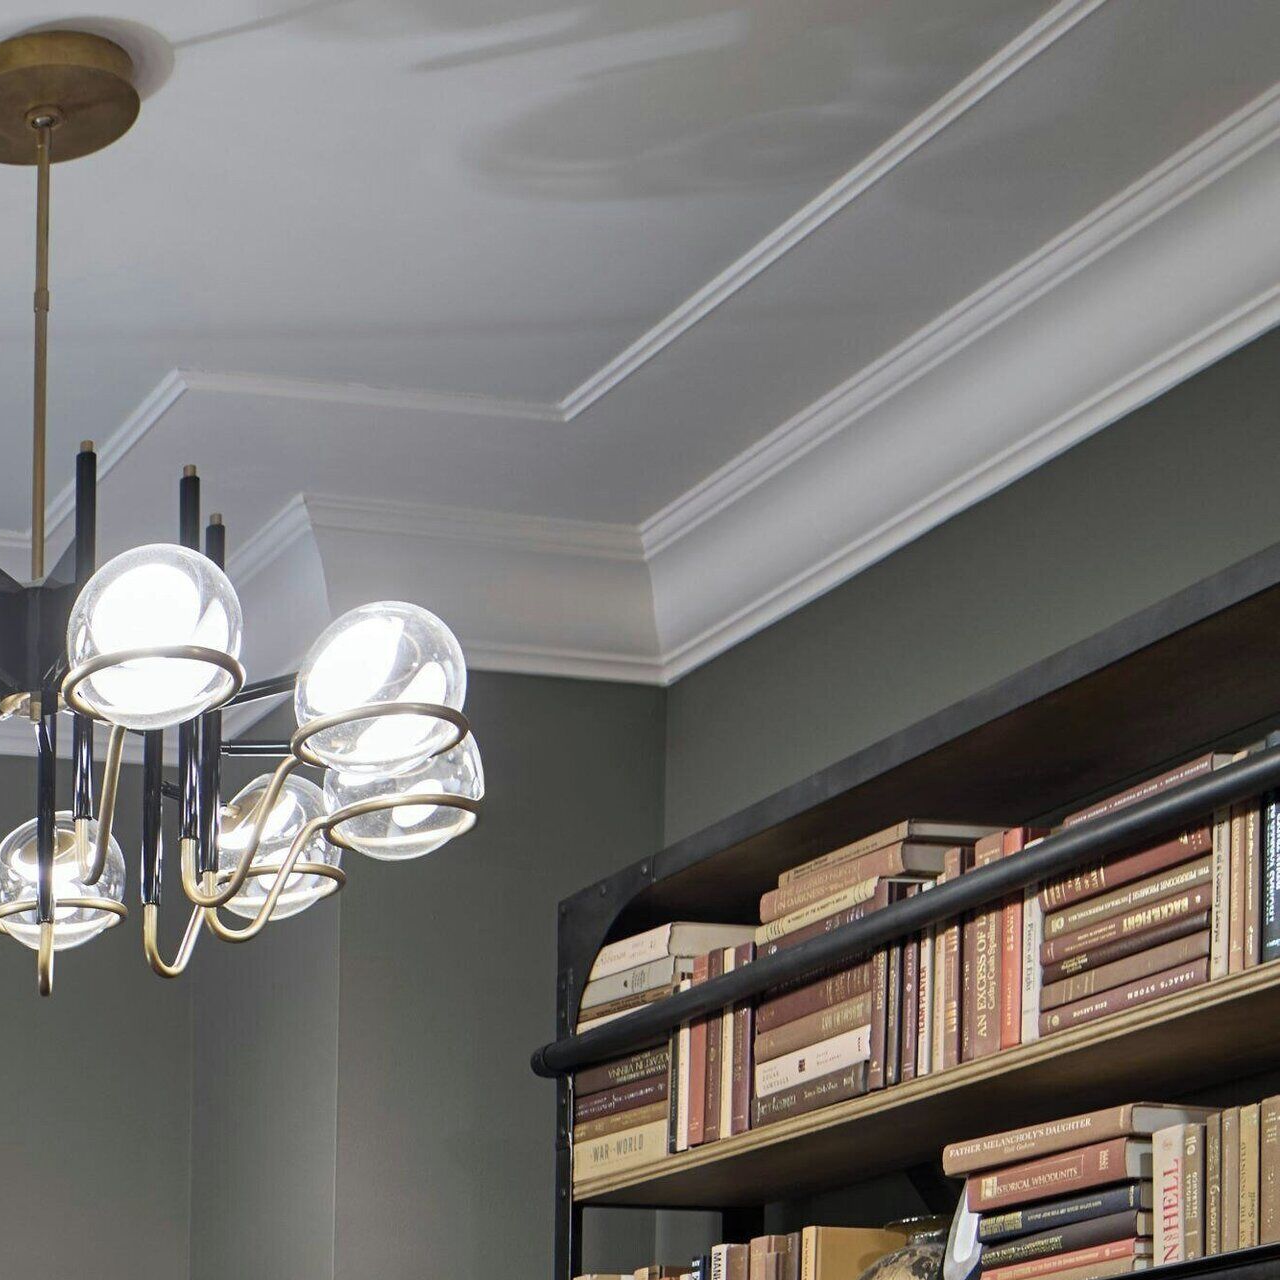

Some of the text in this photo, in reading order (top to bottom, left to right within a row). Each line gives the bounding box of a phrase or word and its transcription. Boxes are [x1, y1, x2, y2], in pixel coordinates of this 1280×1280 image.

[1122, 911, 1152, 932] FIGHT
[977, 931, 986, 951] OF
[977, 955, 986, 1010] EXCESS
[1160, 971, 1194, 988] ISAAC'S
[1126, 984, 1155, 1000] STORM
[977, 1015, 986, 1037] AN
[950, 1118, 1091, 1158] FATHER MELANCHOLY'S DAUGHTER
[1032, 1167, 1078, 1186] WHODUNITS
[1163, 1159, 1179, 1232] HELL
